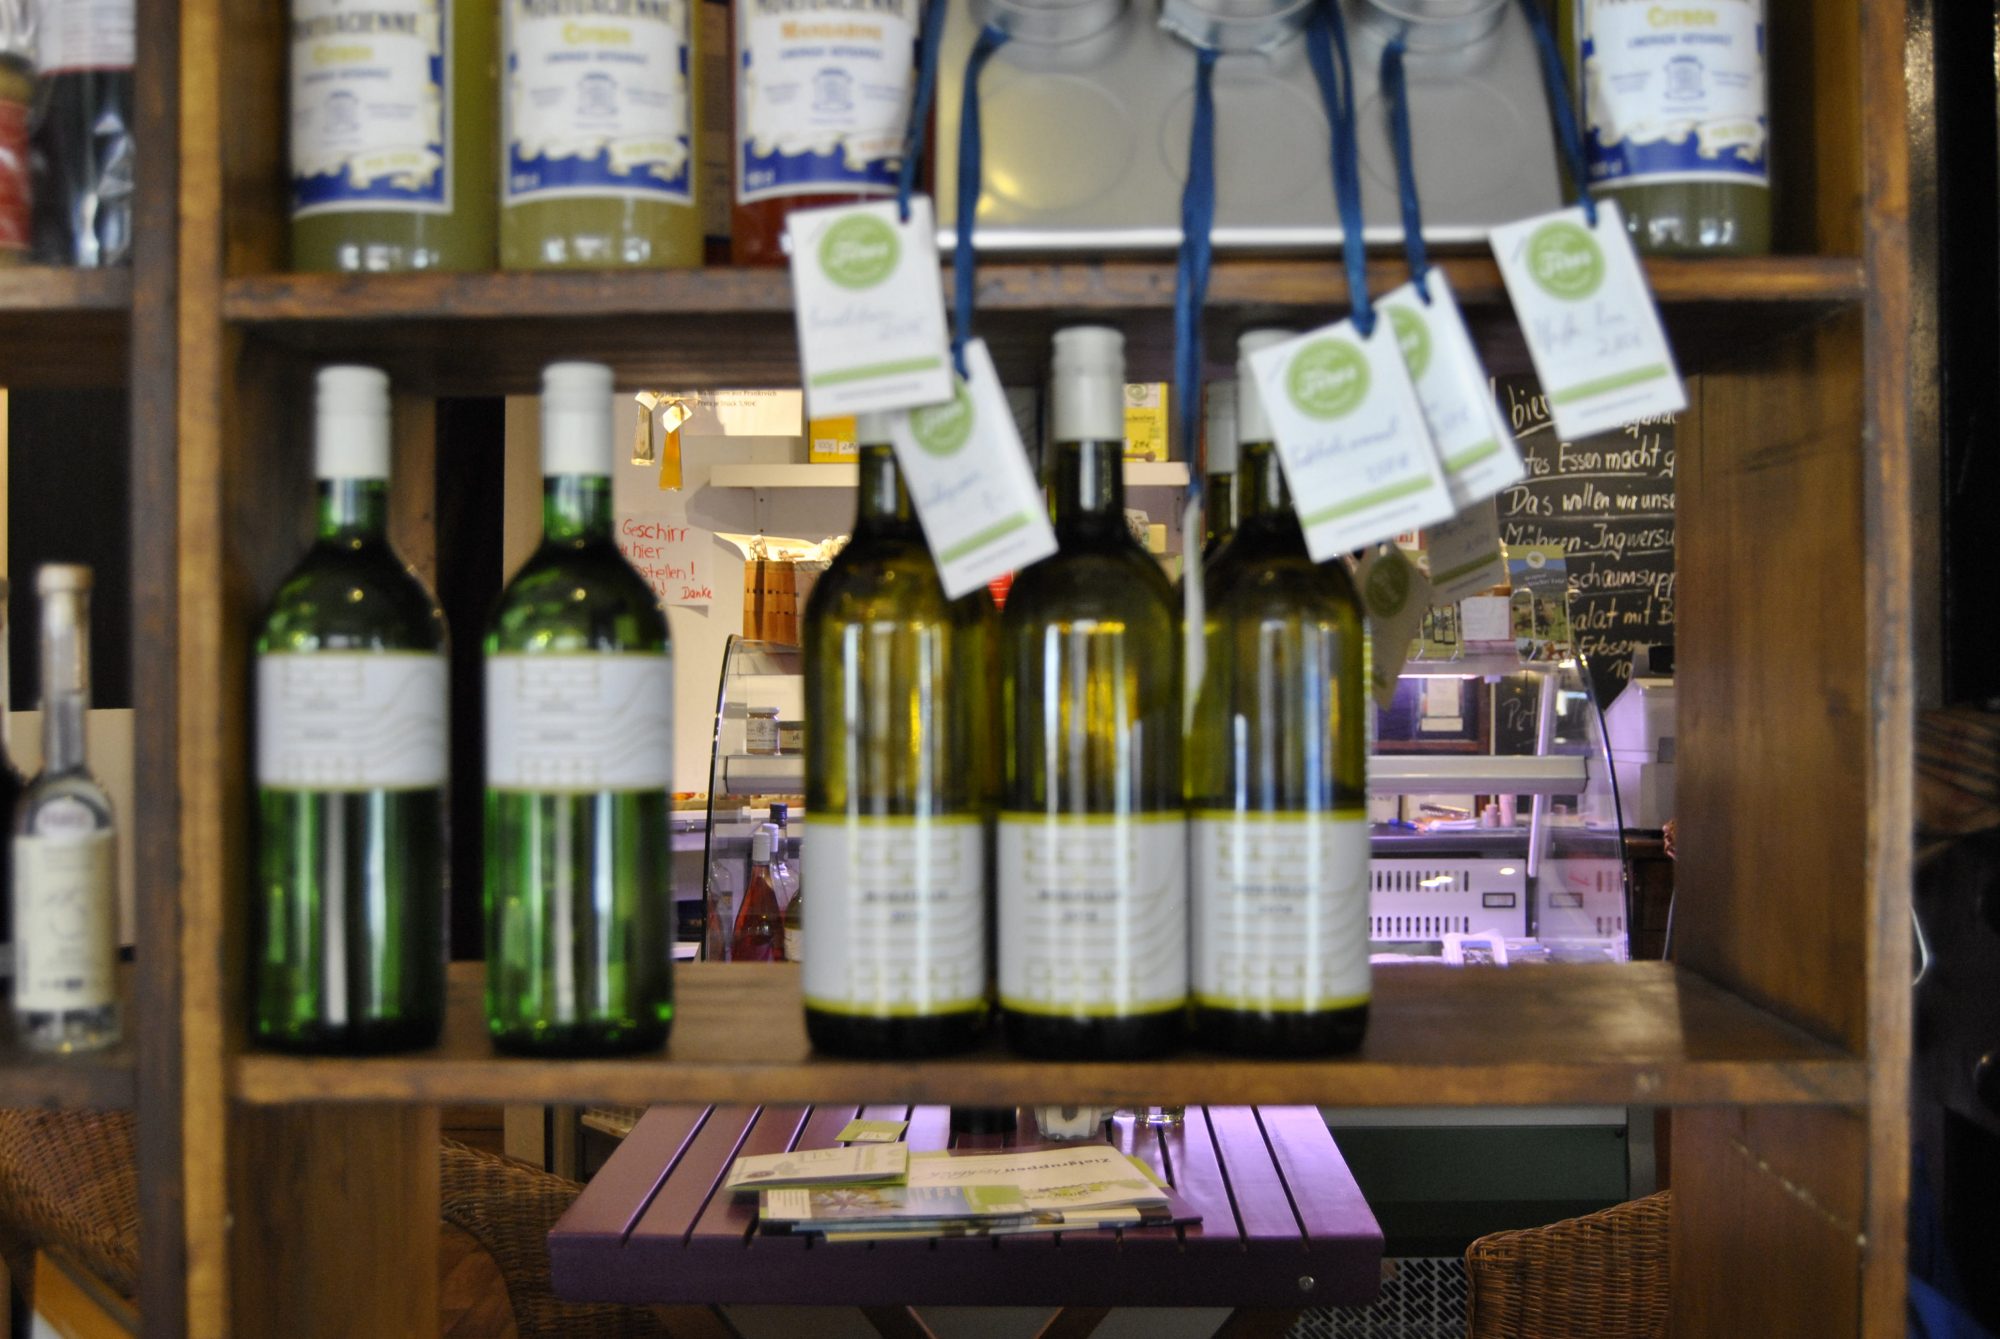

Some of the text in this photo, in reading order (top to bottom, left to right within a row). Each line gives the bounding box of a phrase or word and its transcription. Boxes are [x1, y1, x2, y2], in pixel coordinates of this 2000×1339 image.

[1525, 433, 1676, 478] tes Essen macht g
[1503, 481, 1676, 517] Das wollen wir unse
[622, 518, 690, 542] Geschirr
[632, 542, 665, 560] hier
[681, 584, 713, 600] Danke
[1568, 562, 1677, 598] schaumsupp
[1575, 596, 1619, 632] alat
[1623, 594, 1653, 626] mit
